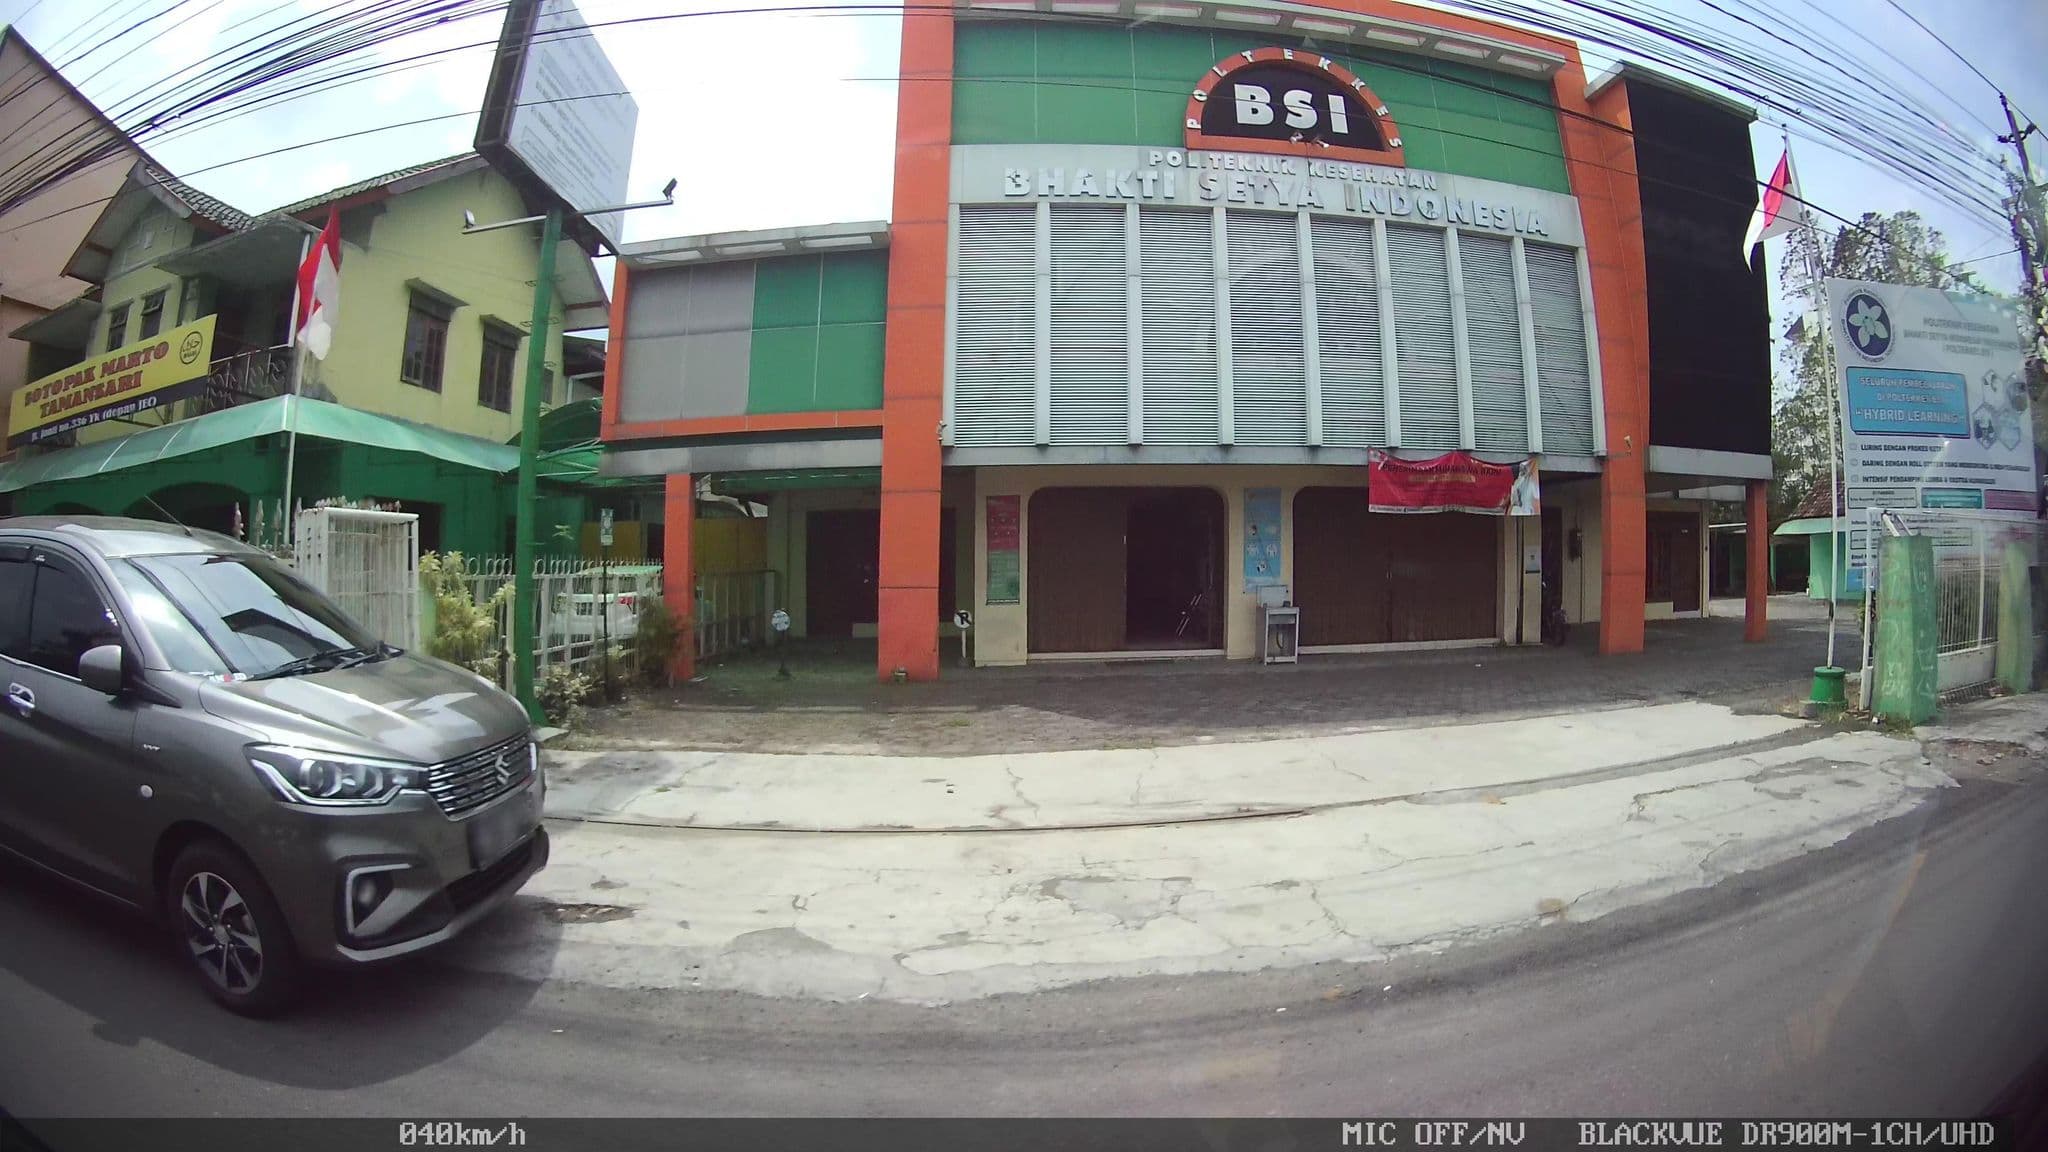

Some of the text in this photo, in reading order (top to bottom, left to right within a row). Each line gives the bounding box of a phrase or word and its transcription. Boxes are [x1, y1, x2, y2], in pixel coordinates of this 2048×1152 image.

[1234, 83, 1349, 134] BSI
[1308, 160, 1438, 191] KESEHATAN
[1005, 167, 1549, 236] BHAKTI SETYA INDONESIA
